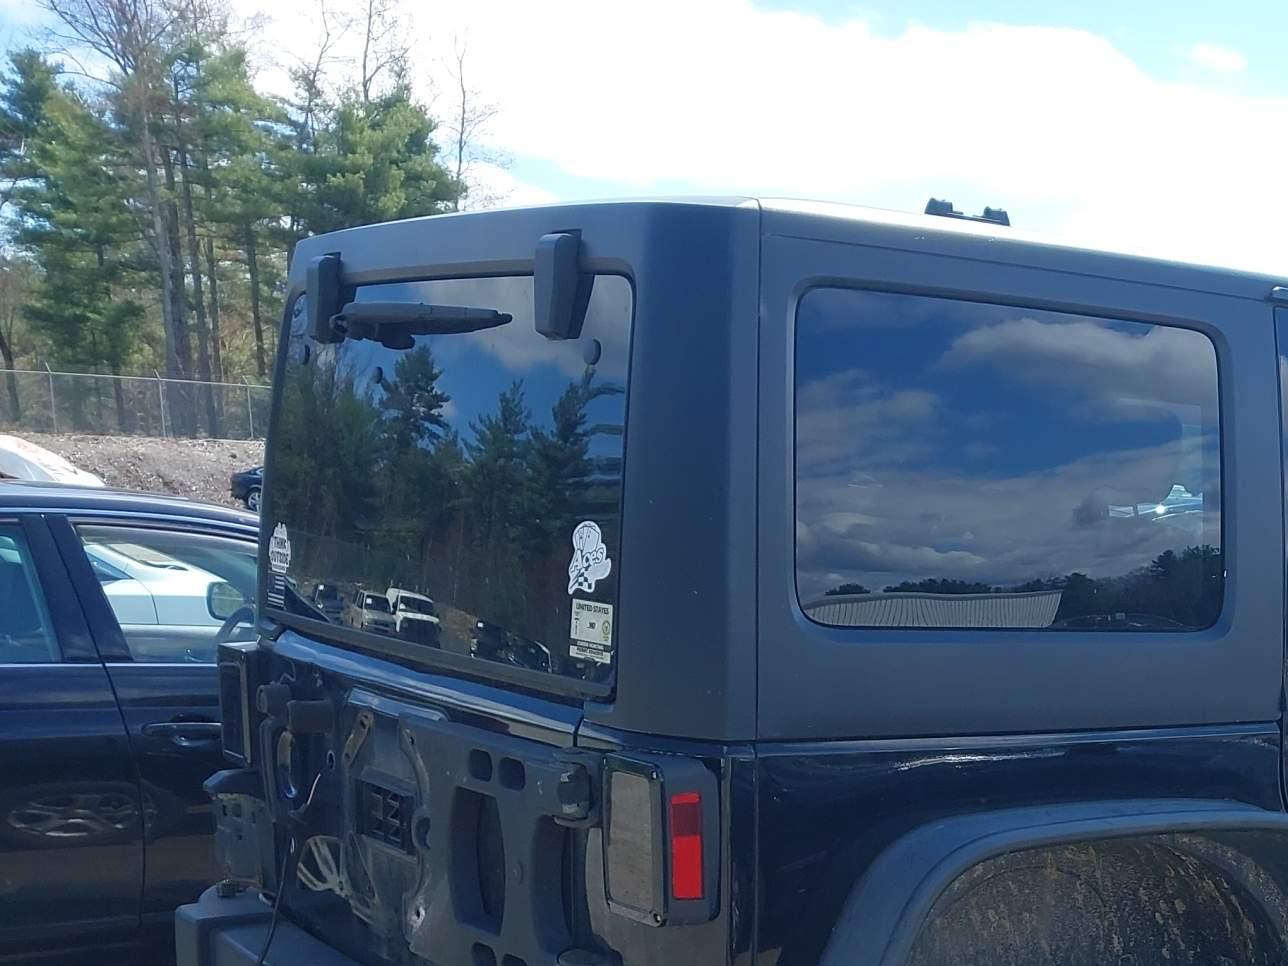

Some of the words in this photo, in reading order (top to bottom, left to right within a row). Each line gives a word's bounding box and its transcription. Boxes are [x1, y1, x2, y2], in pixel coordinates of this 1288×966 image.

[569, 546, 605, 575] Aces
[575, 602, 592, 612] UNITED
[593, 605, 609, 615] STATES
